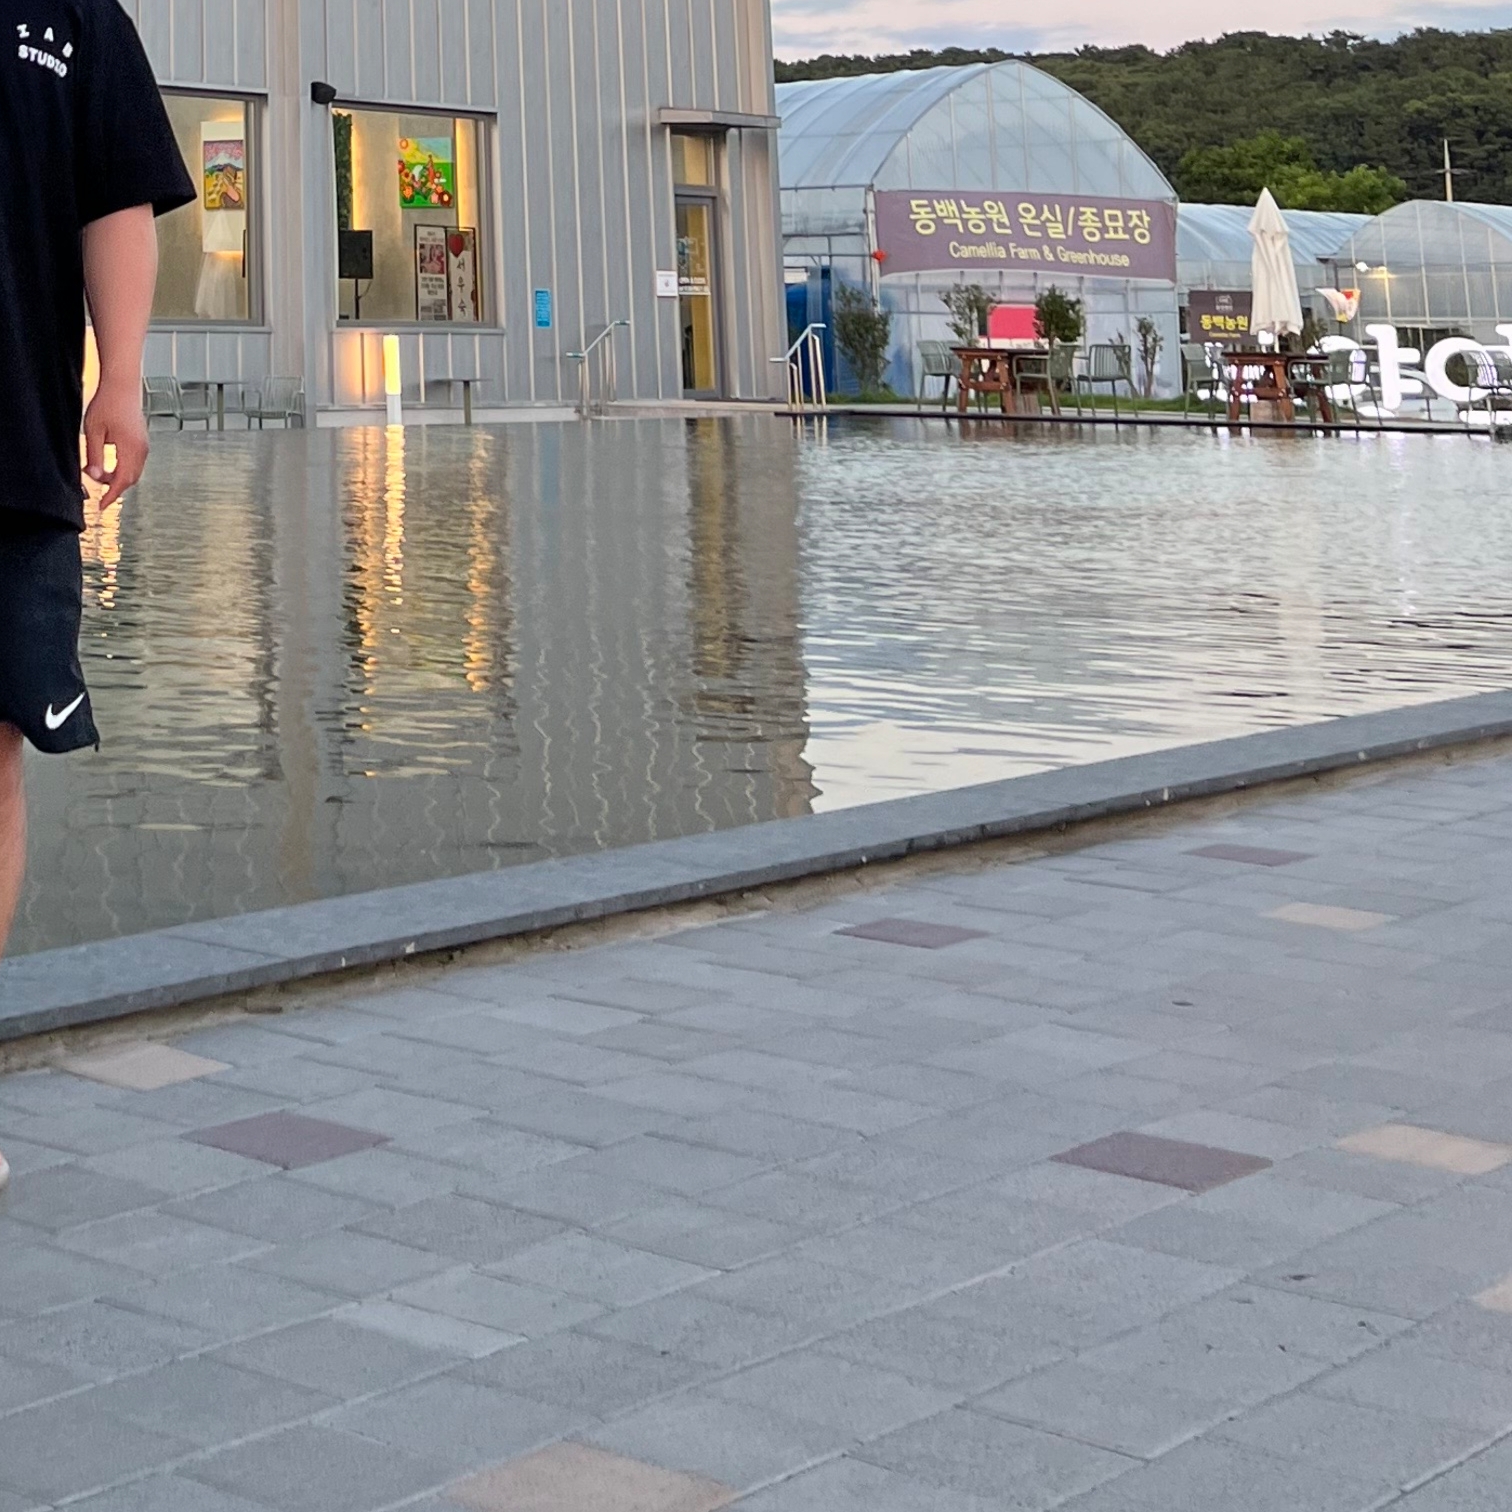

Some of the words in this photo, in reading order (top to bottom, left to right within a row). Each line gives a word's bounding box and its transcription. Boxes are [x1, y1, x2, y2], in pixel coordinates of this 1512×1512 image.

[17, 44, 68, 78] STUDIO
[909, 198, 1013, 236] 동백농원
[1017, 201, 1151, 245] 온실/종묘장
[949, 240, 1007, 259] Camellia
[1008, 242, 1041, 261] Farm
[1042, 244, 1055, 261] &
[1056, 245, 1130, 267] Greenhouse
